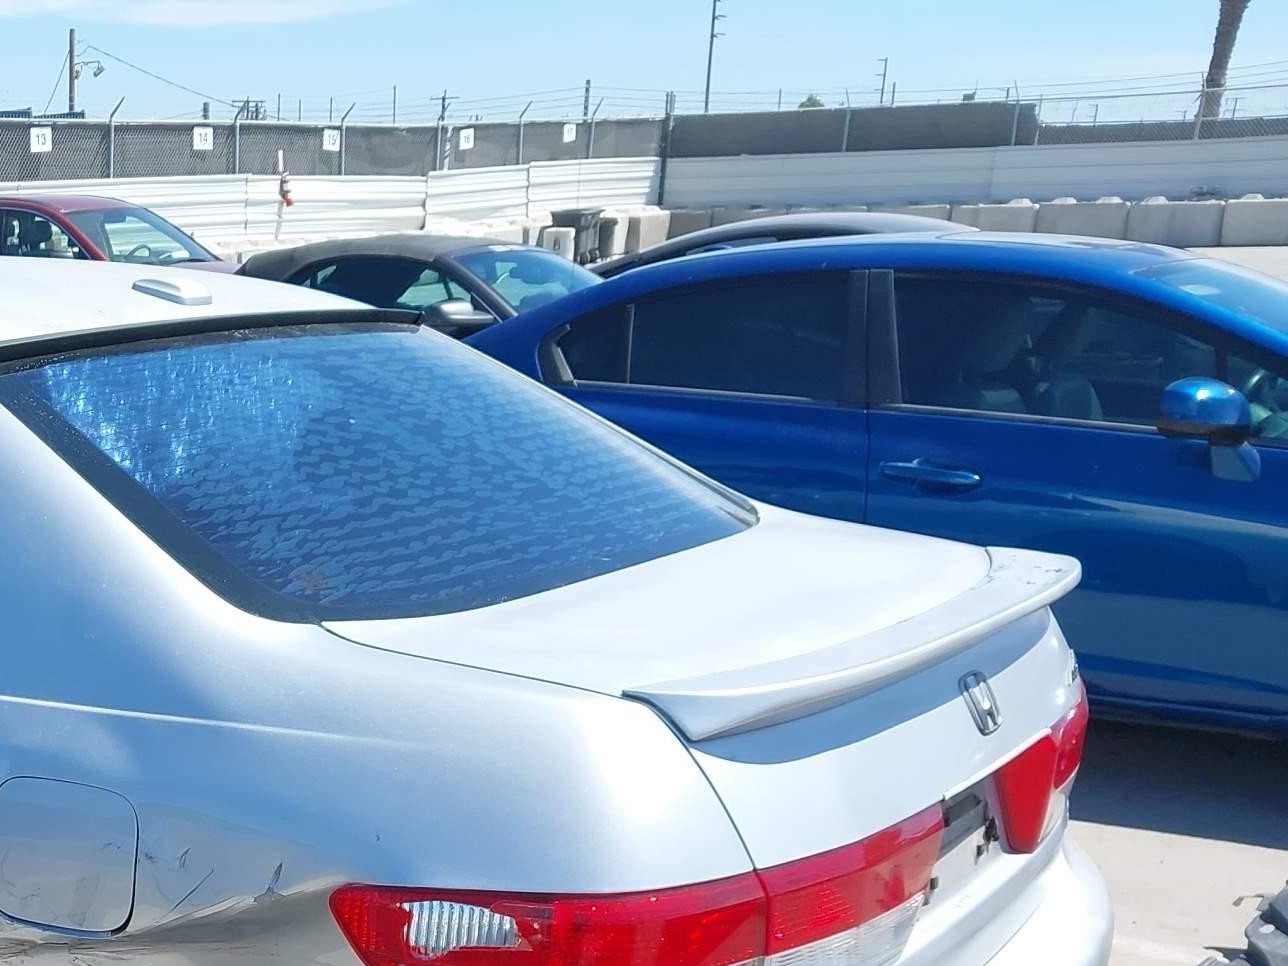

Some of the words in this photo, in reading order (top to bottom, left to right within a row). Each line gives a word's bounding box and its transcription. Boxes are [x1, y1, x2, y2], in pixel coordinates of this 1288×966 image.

[35, 133, 47, 146] 13
[199, 132, 208, 144] 14
[328, 133, 337, 146] 15
